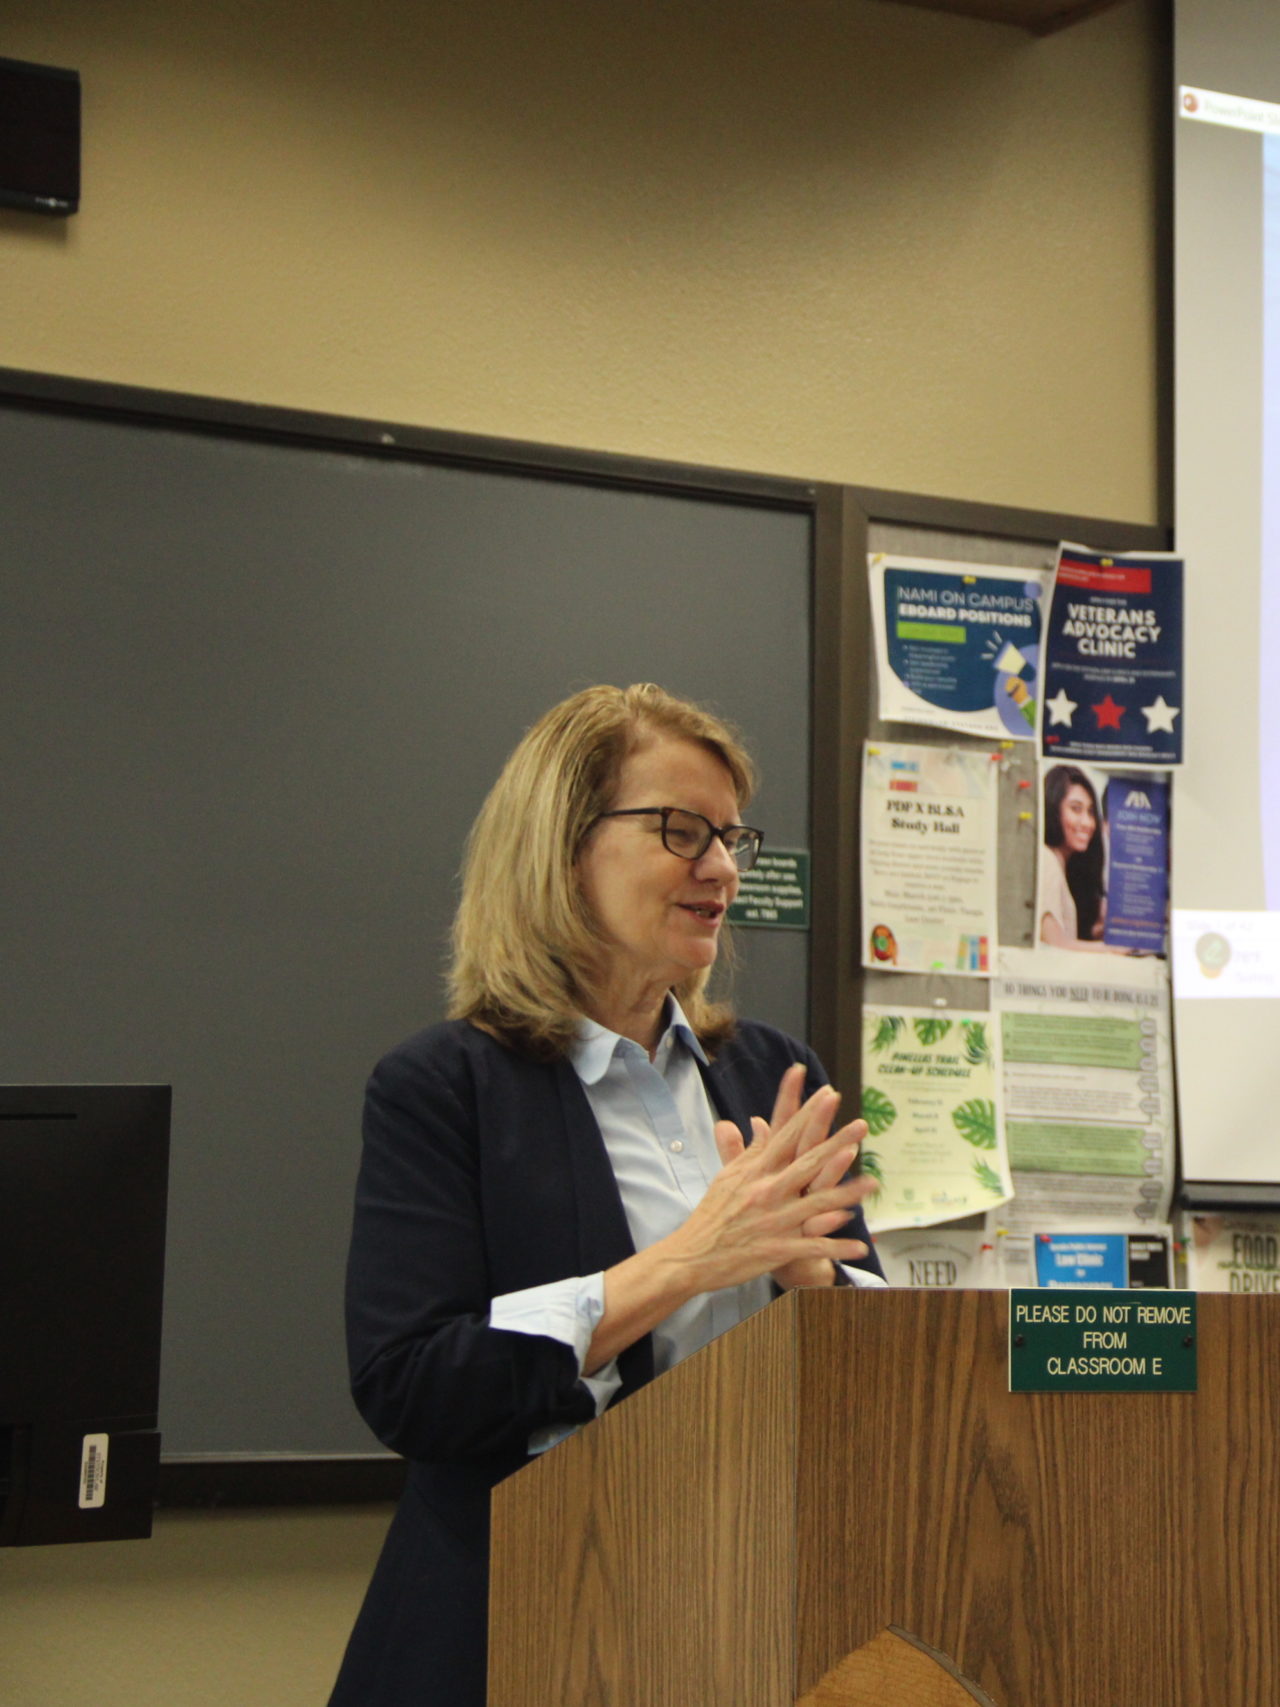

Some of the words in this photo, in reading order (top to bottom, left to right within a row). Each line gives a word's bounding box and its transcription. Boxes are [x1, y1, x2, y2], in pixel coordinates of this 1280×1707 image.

[898, 586, 937, 602] NAMI
[940, 590, 965, 606] ON
[967, 593, 1034, 612] CAMPUS
[899, 603, 956, 620] EBOARD
[959, 609, 1032, 628] POSITIONS
[1067, 602, 1156, 626] VETERANS
[1062, 620, 1162, 643] ADVOCACY
[1077, 638, 1137, 659] CLINIC
[891, 819, 929, 835] Study
[933, 821, 960, 834] Hall
[1232, 1233, 1278, 1269] FOOD
[908, 1260, 958, 1286] NEED
[1016, 1305, 1070, 1323] PLEASE
[1075, 1305, 1097, 1323] DO
[1103, 1306, 1131, 1324] NOT
[1137, 1306, 1191, 1325] REMOVE
[1083, 1332, 1127, 1349] FROM
[1047, 1358, 1146, 1376] CLASSROOM
[1152, 1358, 1162, 1375] E
